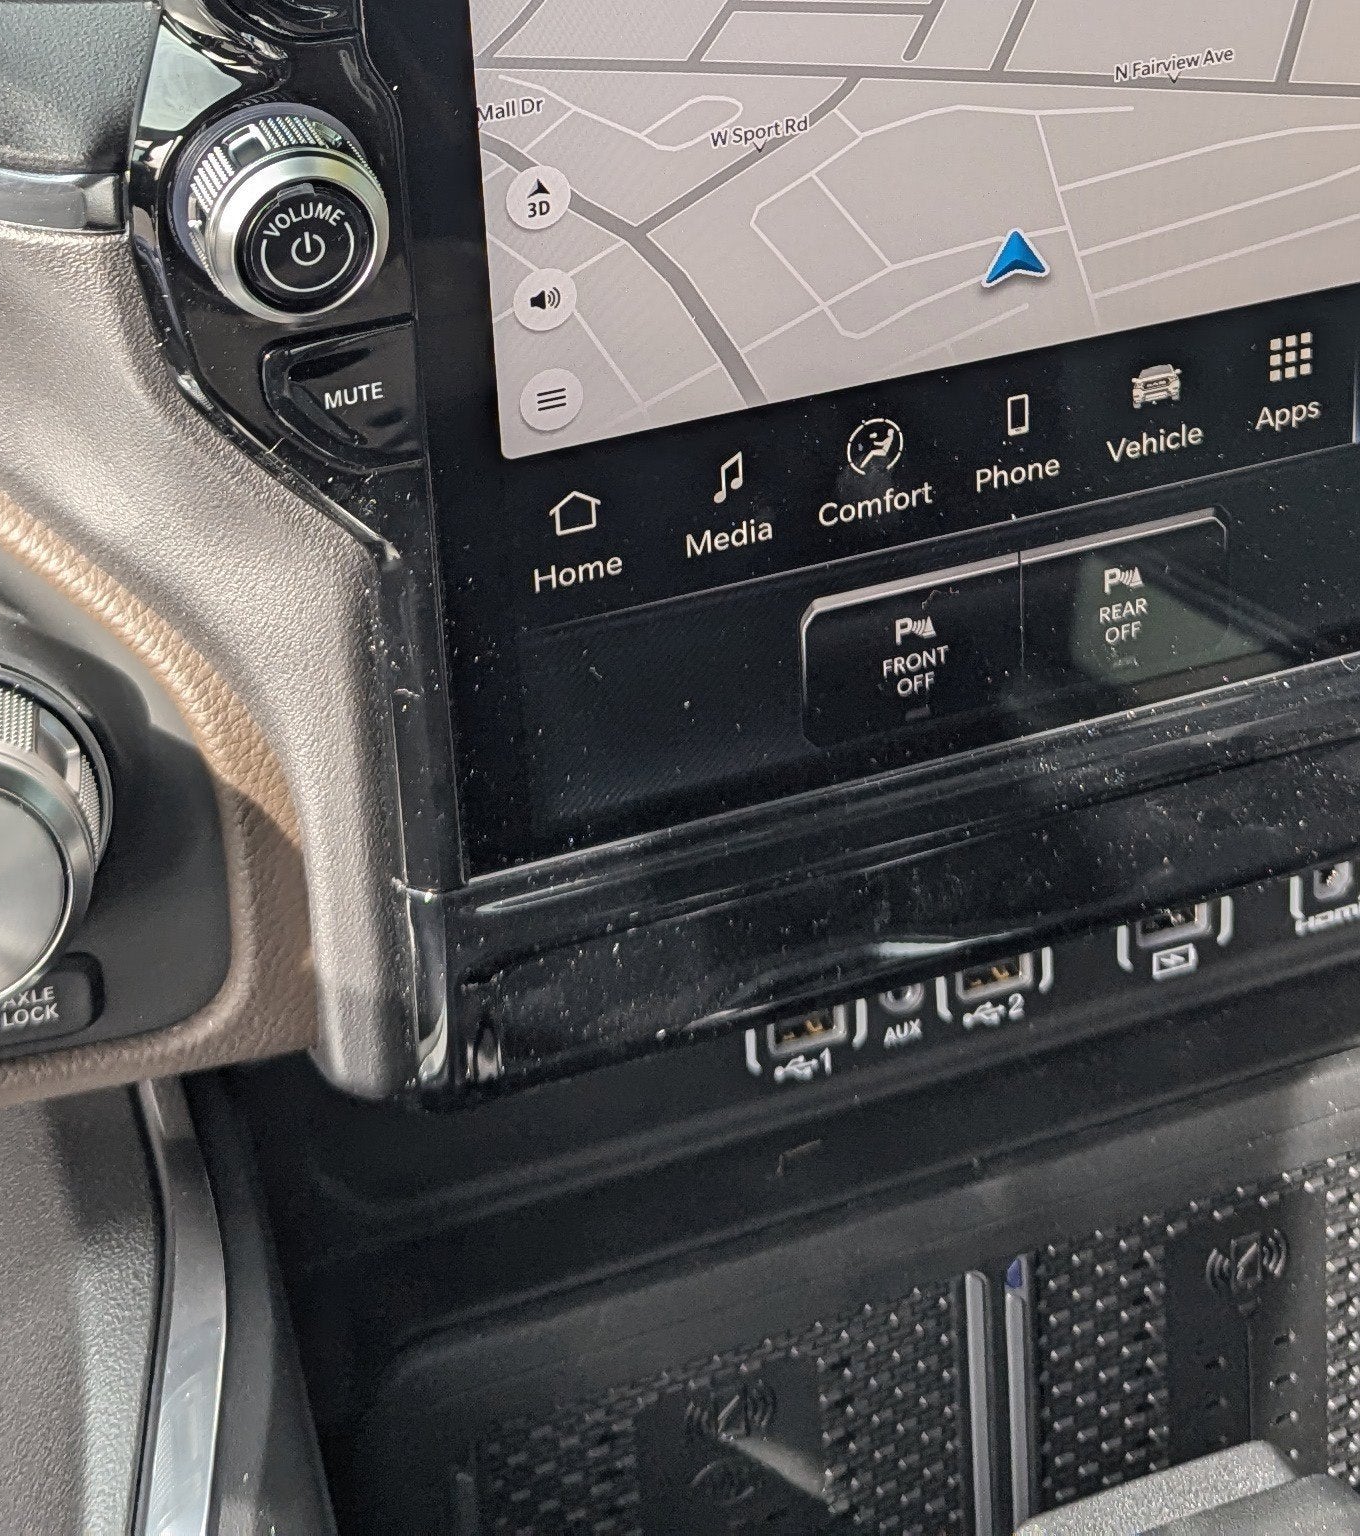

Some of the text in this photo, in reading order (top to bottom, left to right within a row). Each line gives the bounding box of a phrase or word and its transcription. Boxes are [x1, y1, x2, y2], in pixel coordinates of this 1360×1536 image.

[1114, 47, 1235, 82] N Fairview Ave
[477, 98, 544, 121] Mall Dr
[710, 116, 809, 148] W Sport Rd
[262, 201, 346, 238] VOLUME
[526, 200, 551, 219] 3D
[324, 381, 384, 410] MUTE
[1255, 399, 1322, 433] Apps
[1106, 423, 1204, 464] Vehicle
[975, 457, 1061, 493] Phone
[818, 482, 934, 528] Comfort
[685, 519, 774, 559] Media
[532, 555, 624, 594] Home
[1098, 597, 1149, 625] REAR
[1103, 620, 1142, 645] OFF
[882, 643, 949, 679] FRONT
[896, 671, 935, 698] OFF
[1, 1002, 60, 1029] LOCK
[1008, 992, 1025, 1019] 2
[883, 1018, 923, 1048] AUX
